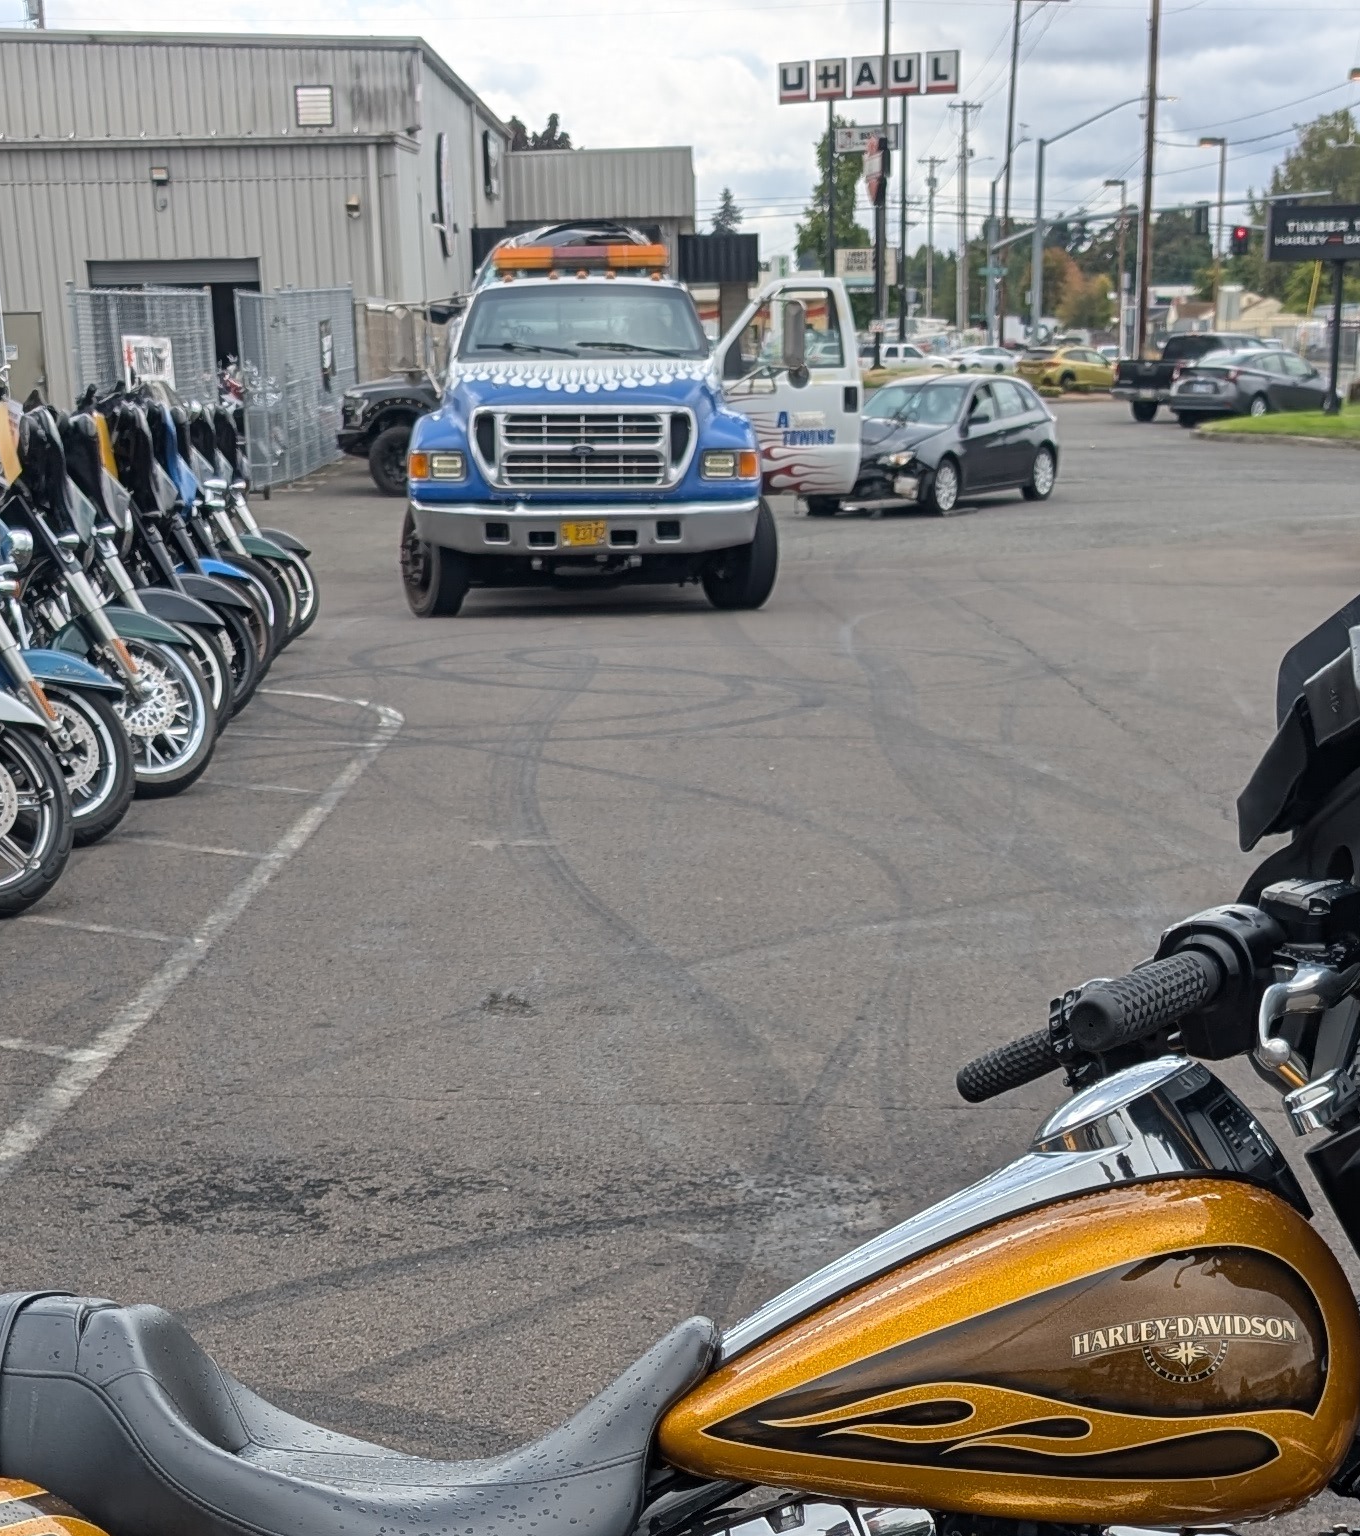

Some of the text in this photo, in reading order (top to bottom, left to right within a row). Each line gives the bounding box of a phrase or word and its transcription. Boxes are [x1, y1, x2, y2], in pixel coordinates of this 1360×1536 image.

[1287, 220, 1349, 232] TIMBER
[776, 411, 789, 428] A
[782, 429, 837, 446] TOWING
[1074, 1315, 1297, 1355] HARLEY-DAVIDSON
